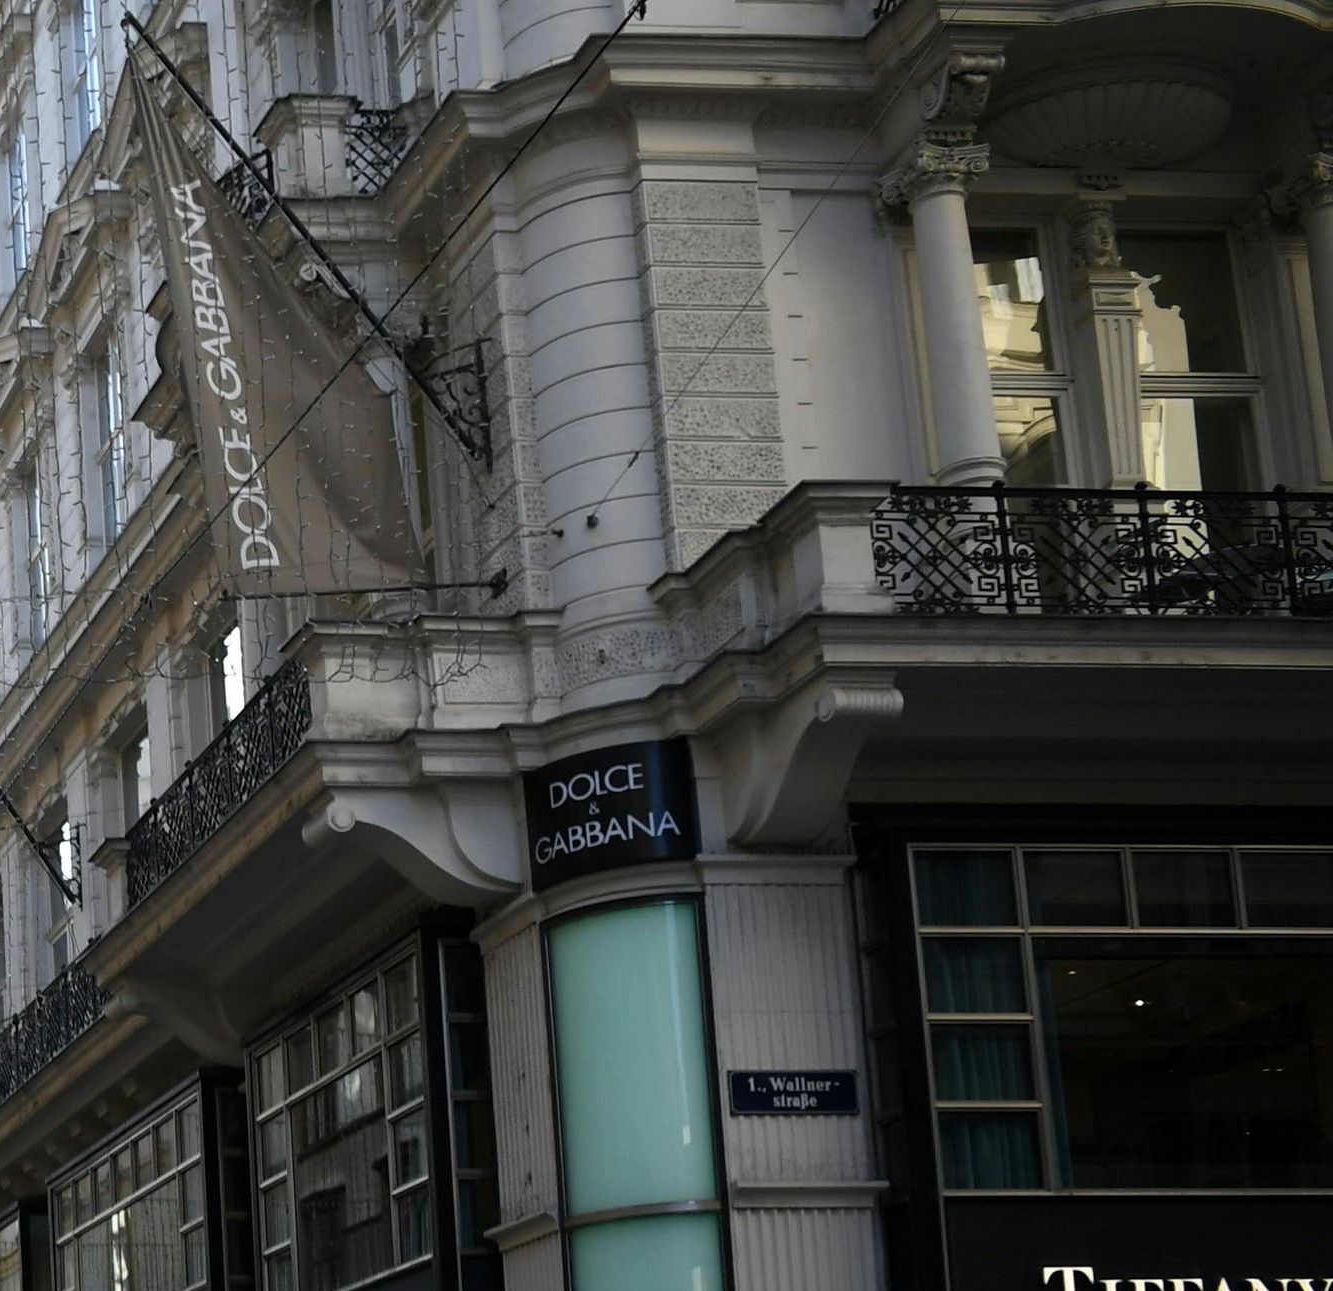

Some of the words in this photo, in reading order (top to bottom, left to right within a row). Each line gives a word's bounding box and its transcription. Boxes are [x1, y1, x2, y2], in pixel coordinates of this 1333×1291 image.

[171, 179, 243, 401] GABBANA
[230, 406, 248, 424] &
[217, 427, 281, 570] DOLCE
[549, 763, 644, 809] DOLCE
[588, 801, 600, 815] &
[535, 810, 681, 865] GABBANA
[773, 1093, 818, 1110] straße
